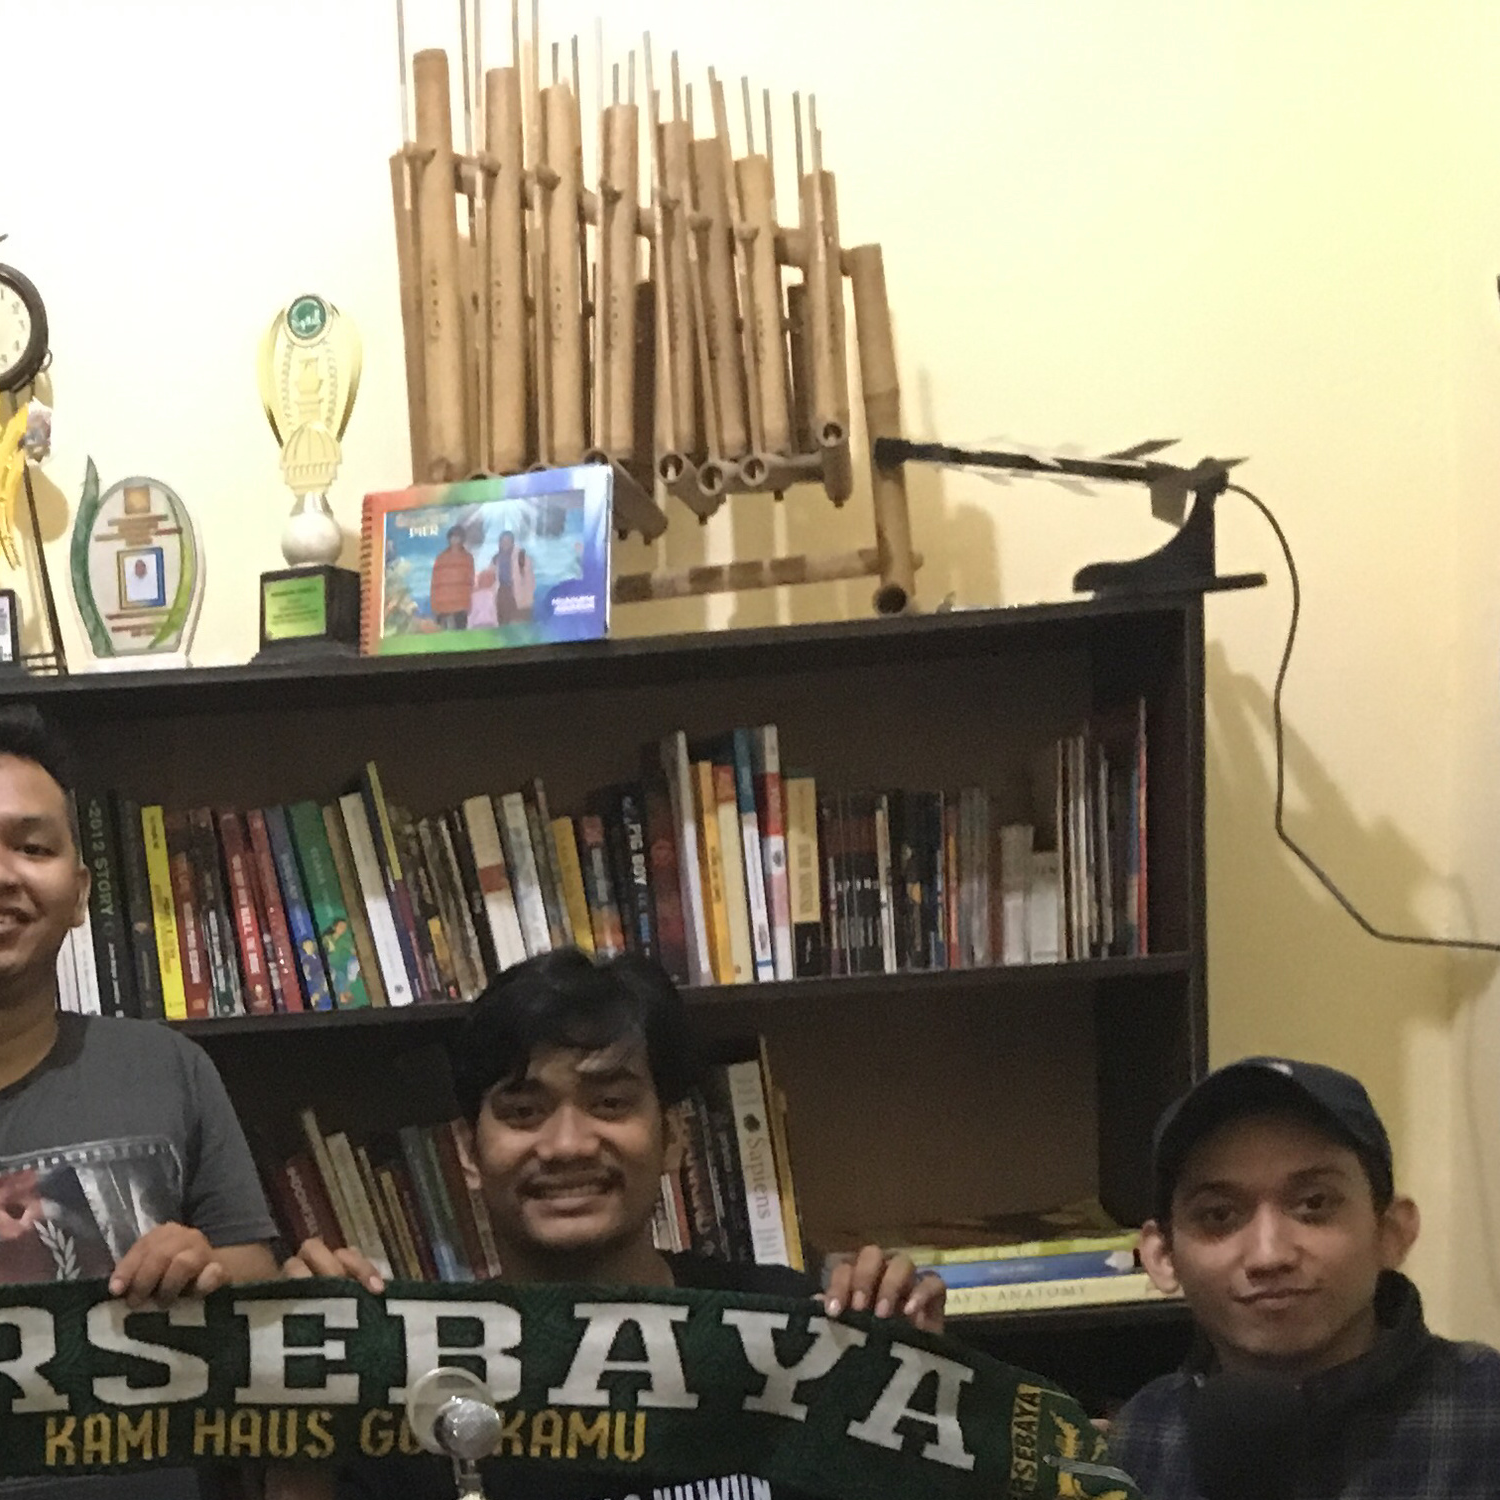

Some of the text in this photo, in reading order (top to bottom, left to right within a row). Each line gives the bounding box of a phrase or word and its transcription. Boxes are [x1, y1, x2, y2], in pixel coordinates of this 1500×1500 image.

[95, 857, 114, 916] STORY
[746, 1136, 771, 1220] Sapiens
[1000, 1283, 1087, 1301] ANATOMY
[45, 1407, 169, 1466] KAMI
[194, 1406, 335, 1459] HAUS
[497, 1409, 647, 1462] KAMU
